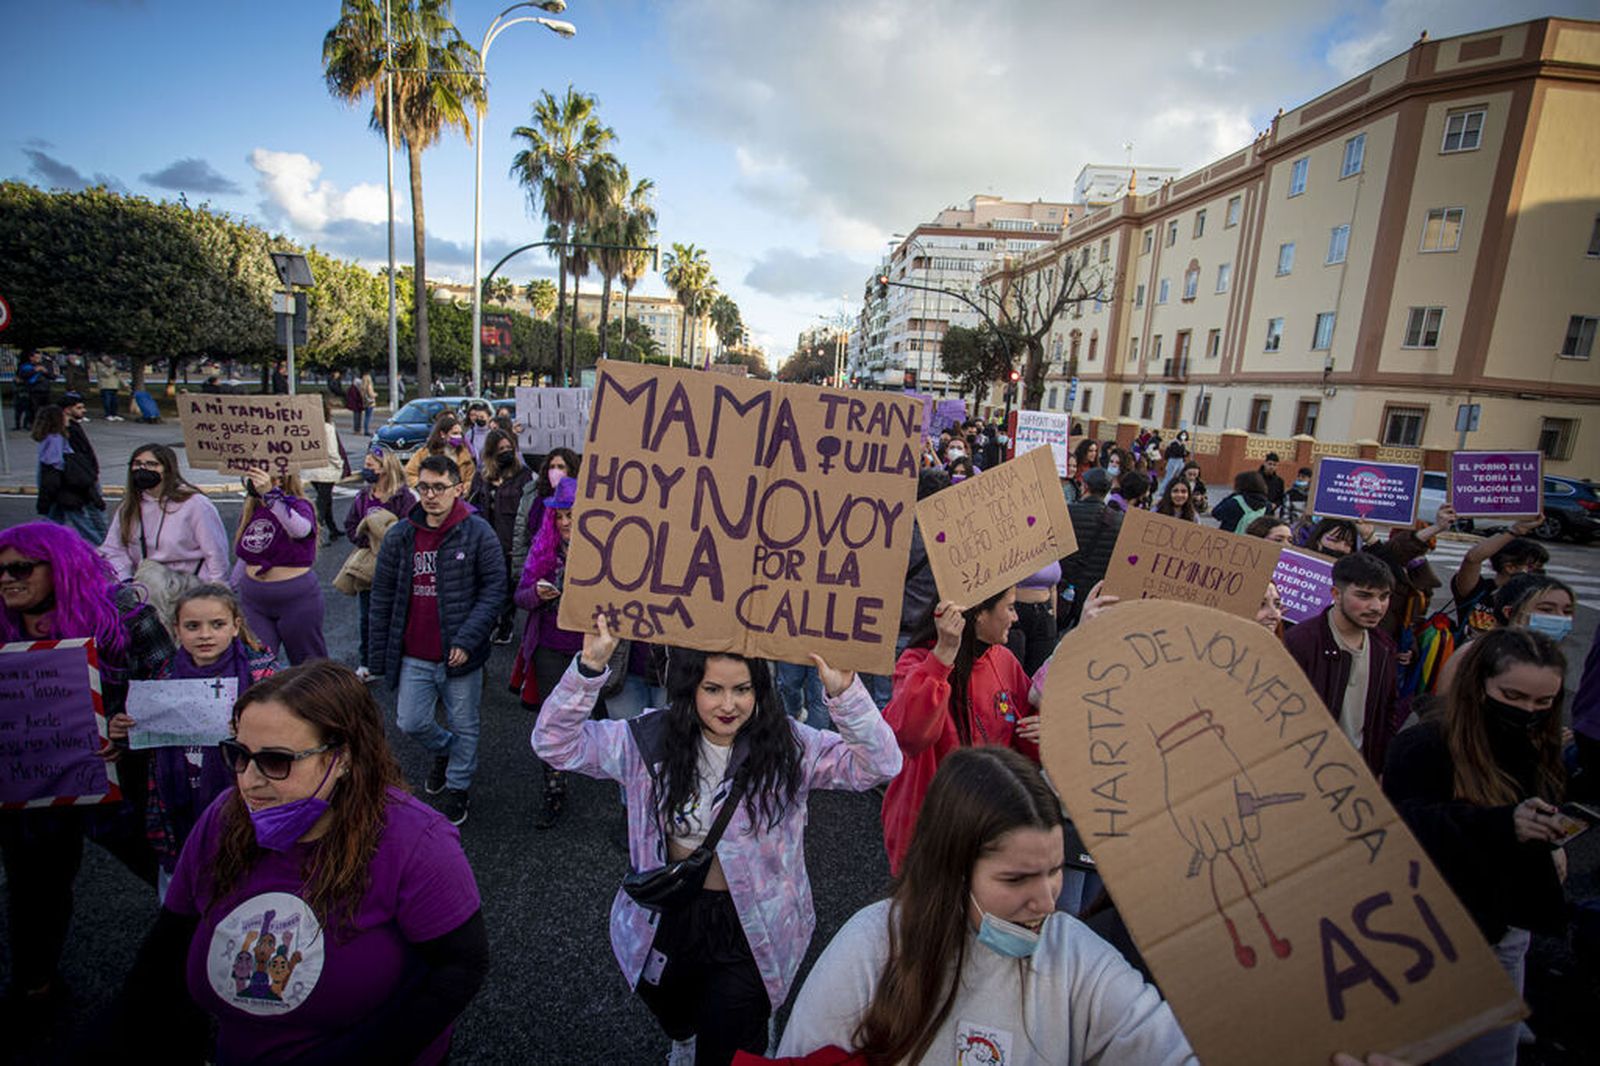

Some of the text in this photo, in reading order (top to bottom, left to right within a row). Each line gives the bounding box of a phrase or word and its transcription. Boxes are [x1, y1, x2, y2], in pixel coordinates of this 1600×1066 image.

[191, 401, 201, 414] A
[589, 370, 807, 473] MAMA
[818, 393, 921, 438] TRAN-
[221, 422, 275, 440] gustan
[267, 440, 293, 455] NO
[300, 439, 321, 451] LAS
[1472, 473, 1522, 482] TEORÍA LA
[1509, 463, 1520, 471] ES
[1523, 463, 1535, 471] LA
[585, 454, 903, 550] HOY NO VOY
[1456, 484, 1536, 493] VIOLACIÓN ES LA
[1473, 495, 1521, 504] PRÁCTICA
[570, 509, 861, 603] SOLA POR LA
[1141, 519, 1262, 569] EDUCAR EN
[1151, 553, 1244, 596] FEMINISMO
[1276, 583, 1322, 605] QUE LAS
[592, 584, 884, 643] #8M CALLE
[1081, 625, 1387, 864] HARTAS DE VOLVER A CASA
[1319, 860, 1458, 1022] ASÍ
